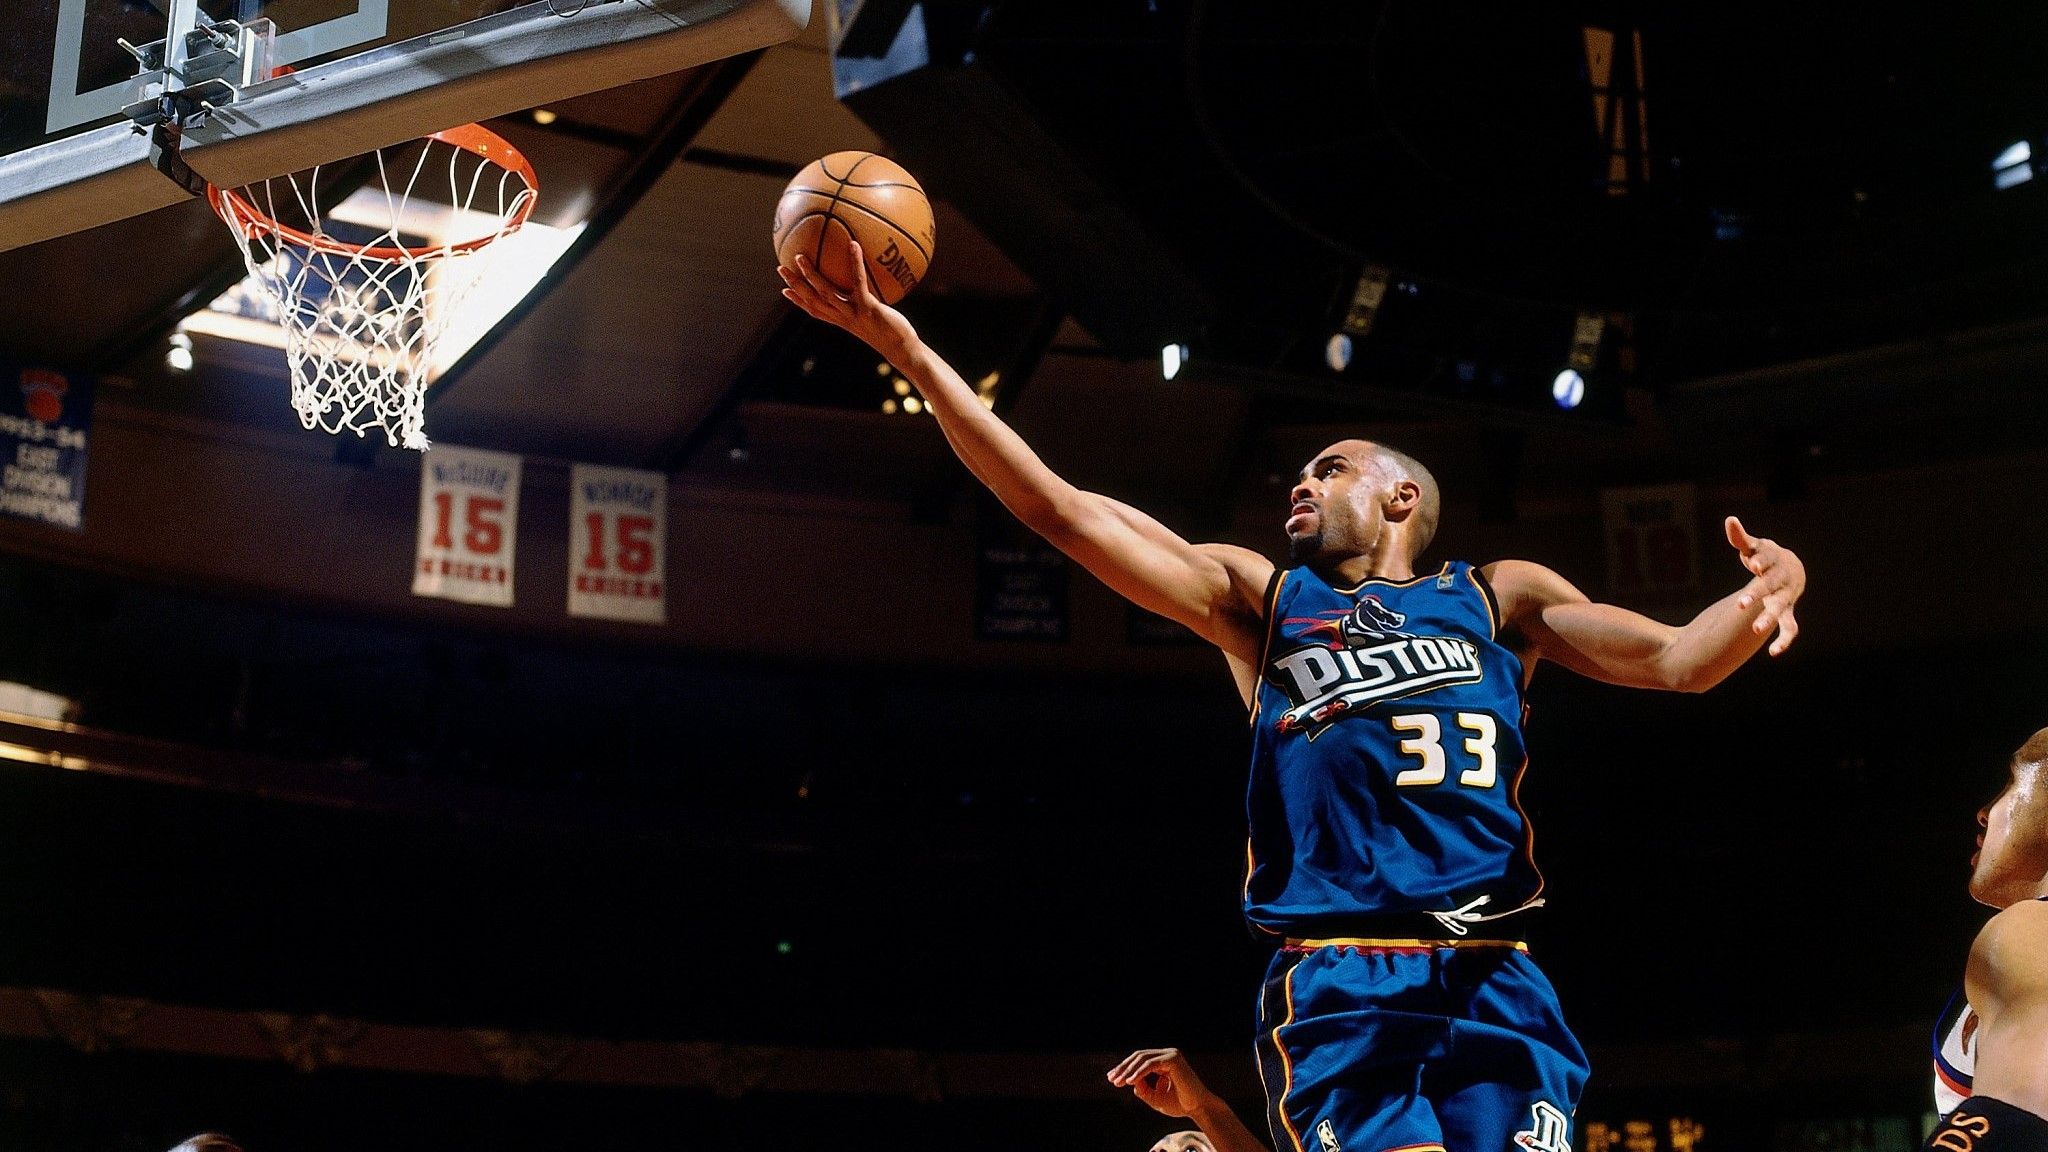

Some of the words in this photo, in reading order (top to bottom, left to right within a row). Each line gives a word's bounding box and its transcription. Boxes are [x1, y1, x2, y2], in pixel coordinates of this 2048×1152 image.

[433, 492, 504, 555] 15
[584, 511, 655, 574] 15
[1272, 634, 1482, 704] PISTONS
[1391, 712, 1497, 788] 33
